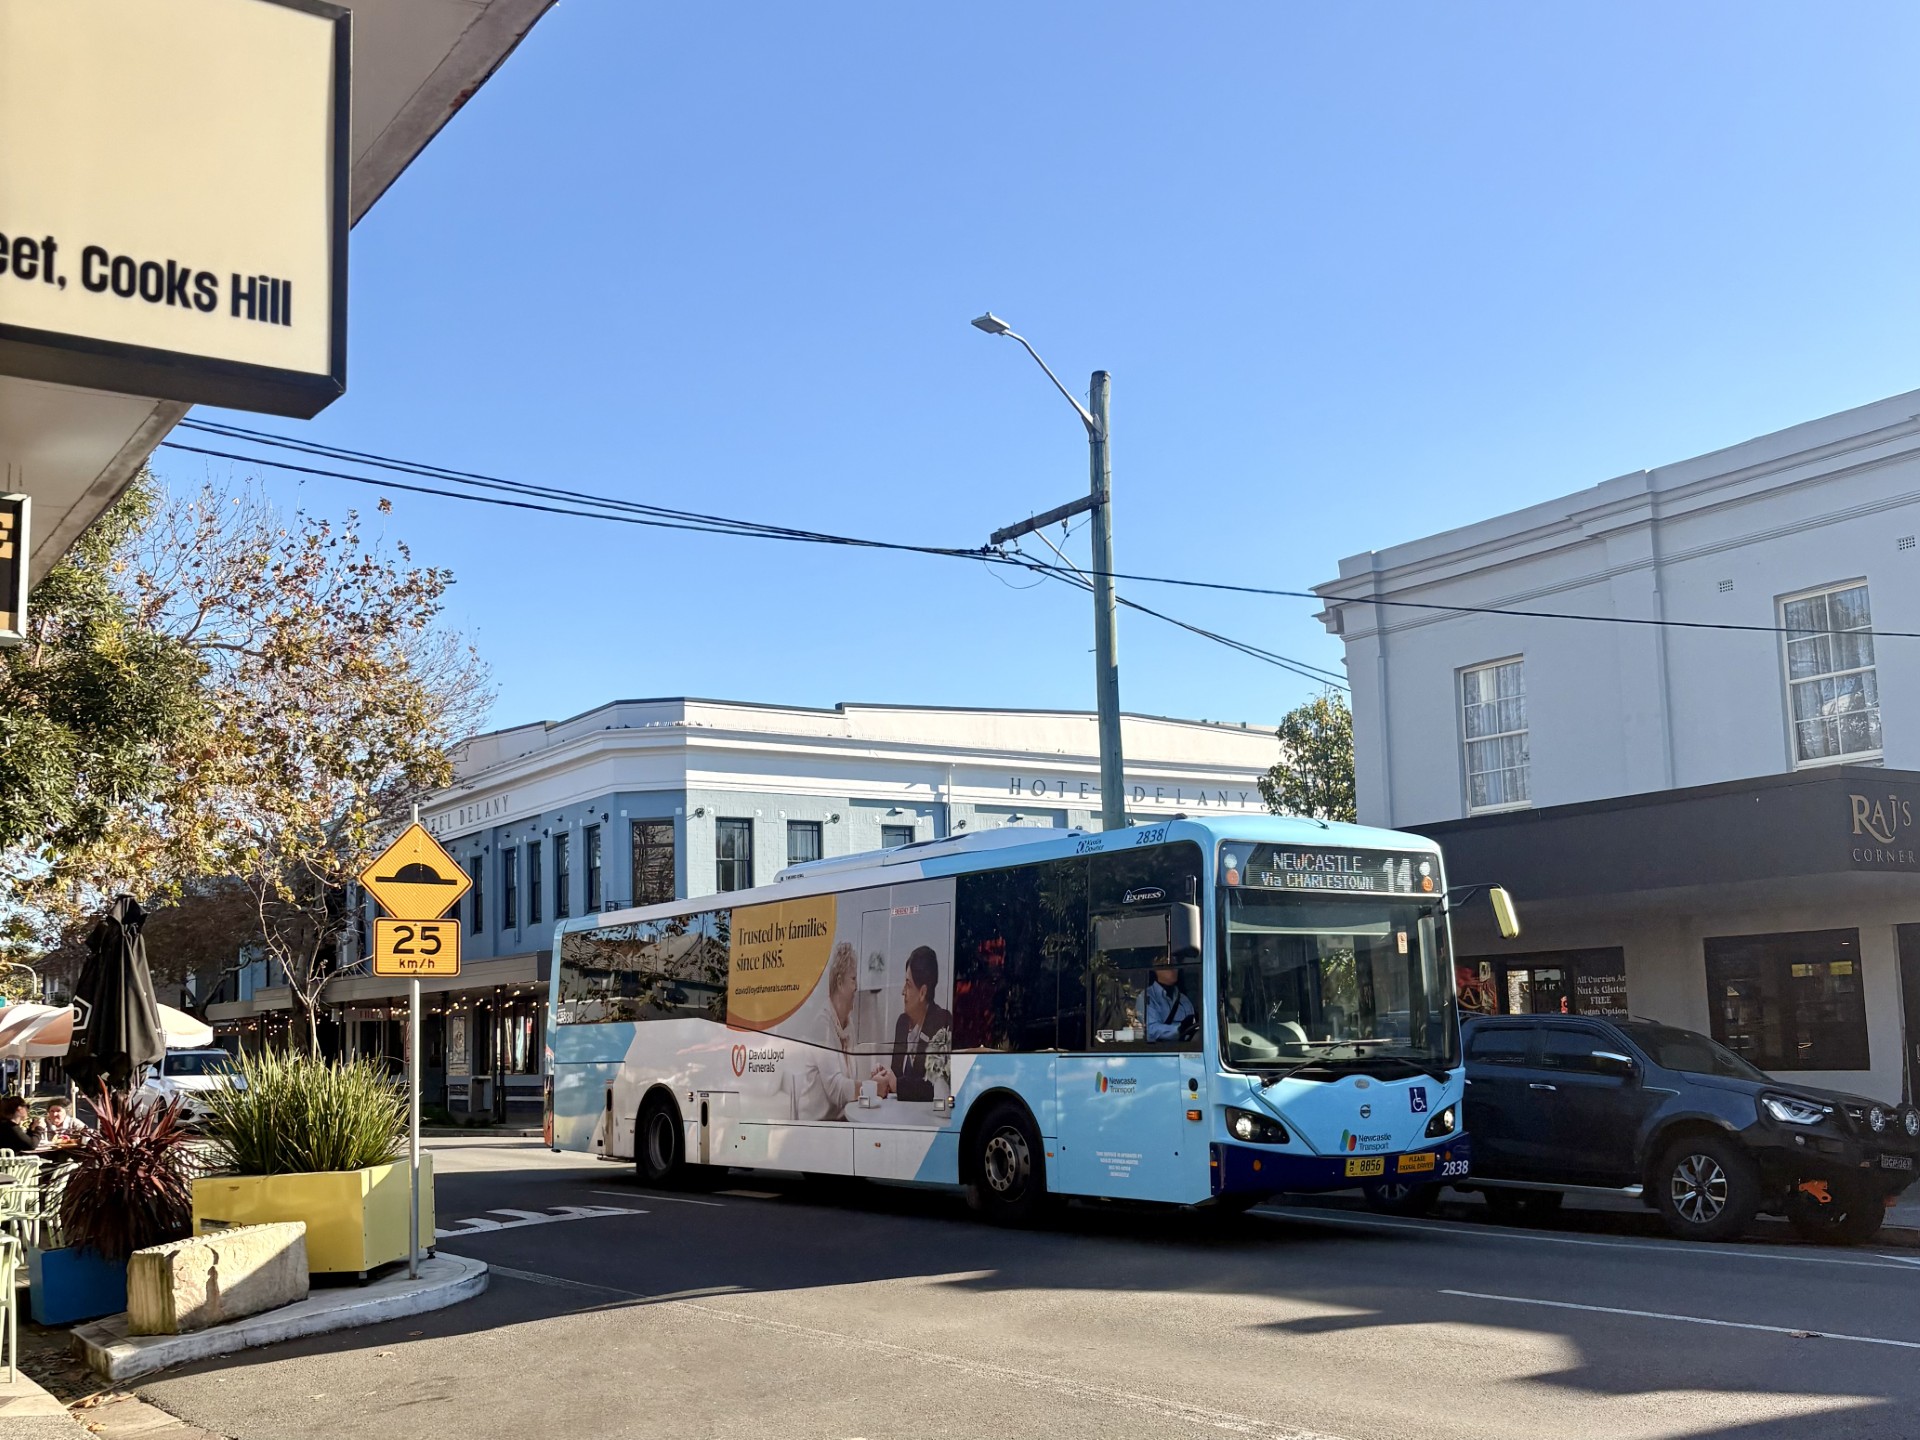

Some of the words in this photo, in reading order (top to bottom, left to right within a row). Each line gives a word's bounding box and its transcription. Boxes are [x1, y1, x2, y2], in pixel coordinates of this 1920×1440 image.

[82, 245, 219, 313] Cooks
[231, 273, 292, 327] Hill
[1009, 777, 1091, 800] HOTE
[1132, 786, 1249, 809] DELANY
[460, 794, 509, 826] DELANY
[1136, 828, 1165, 845] 2838
[1273, 852, 1363, 874] NEWCASTLE
[1853, 848, 1915, 863] CORNER
[1261, 872, 1282, 887] Via
[1286, 873, 1375, 890] CHARLESTOWN
[1382, 857, 1413, 893] 14
[1126, 890, 1162, 902] EXPRESS
[739, 923, 774, 946] Trusted
[775, 922, 788, 946] by
[788, 917, 828, 940] families
[393, 926, 442, 955] 25
[399, 959, 435, 969] km/h
[736, 953, 760, 972] since
[762, 949, 785, 970] 1885.
[1577, 986, 1592, 995] Nut
[1593, 986, 1600, 994] &
[1590, 995, 1612, 1005] FREE
[748, 1048, 767, 1060] David
[767, 1048, 785, 1062] Lloyd
[748, 1061, 776, 1073] Funerals
[1109, 1077, 1137, 1085] Newcastle
[1110, 1086, 1136, 1094] Transport
[1358, 1133, 1392, 1142] Newcastle
[1359, 1142, 1389, 1152] Transport
[1360, 1159, 1382, 1172] 8856
[1441, 1160, 1469, 1176] 2838
